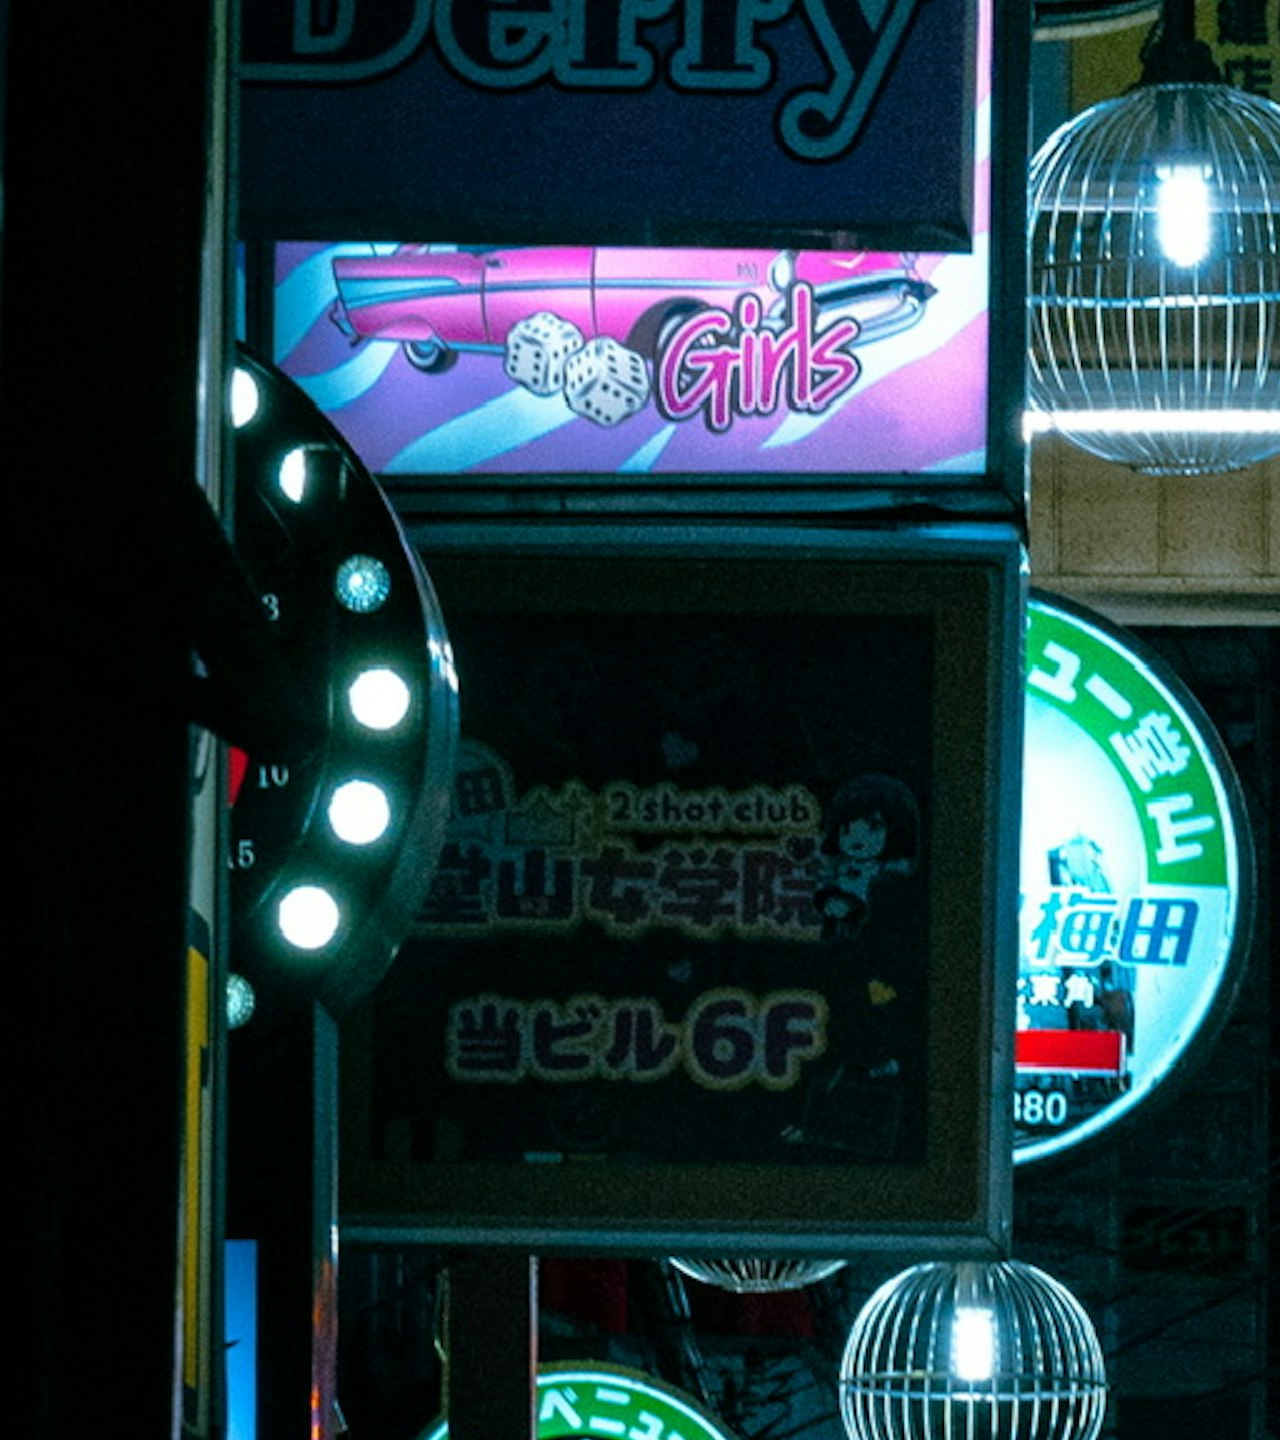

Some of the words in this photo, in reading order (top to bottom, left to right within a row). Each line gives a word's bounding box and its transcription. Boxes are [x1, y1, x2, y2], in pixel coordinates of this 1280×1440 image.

[650, 282, 864, 432] Girls
[610, 788, 631, 822] 2
[641, 785, 724, 823] shot
[734, 780, 811, 825] club
[457, 998, 818, 1082] 当ビル6F
